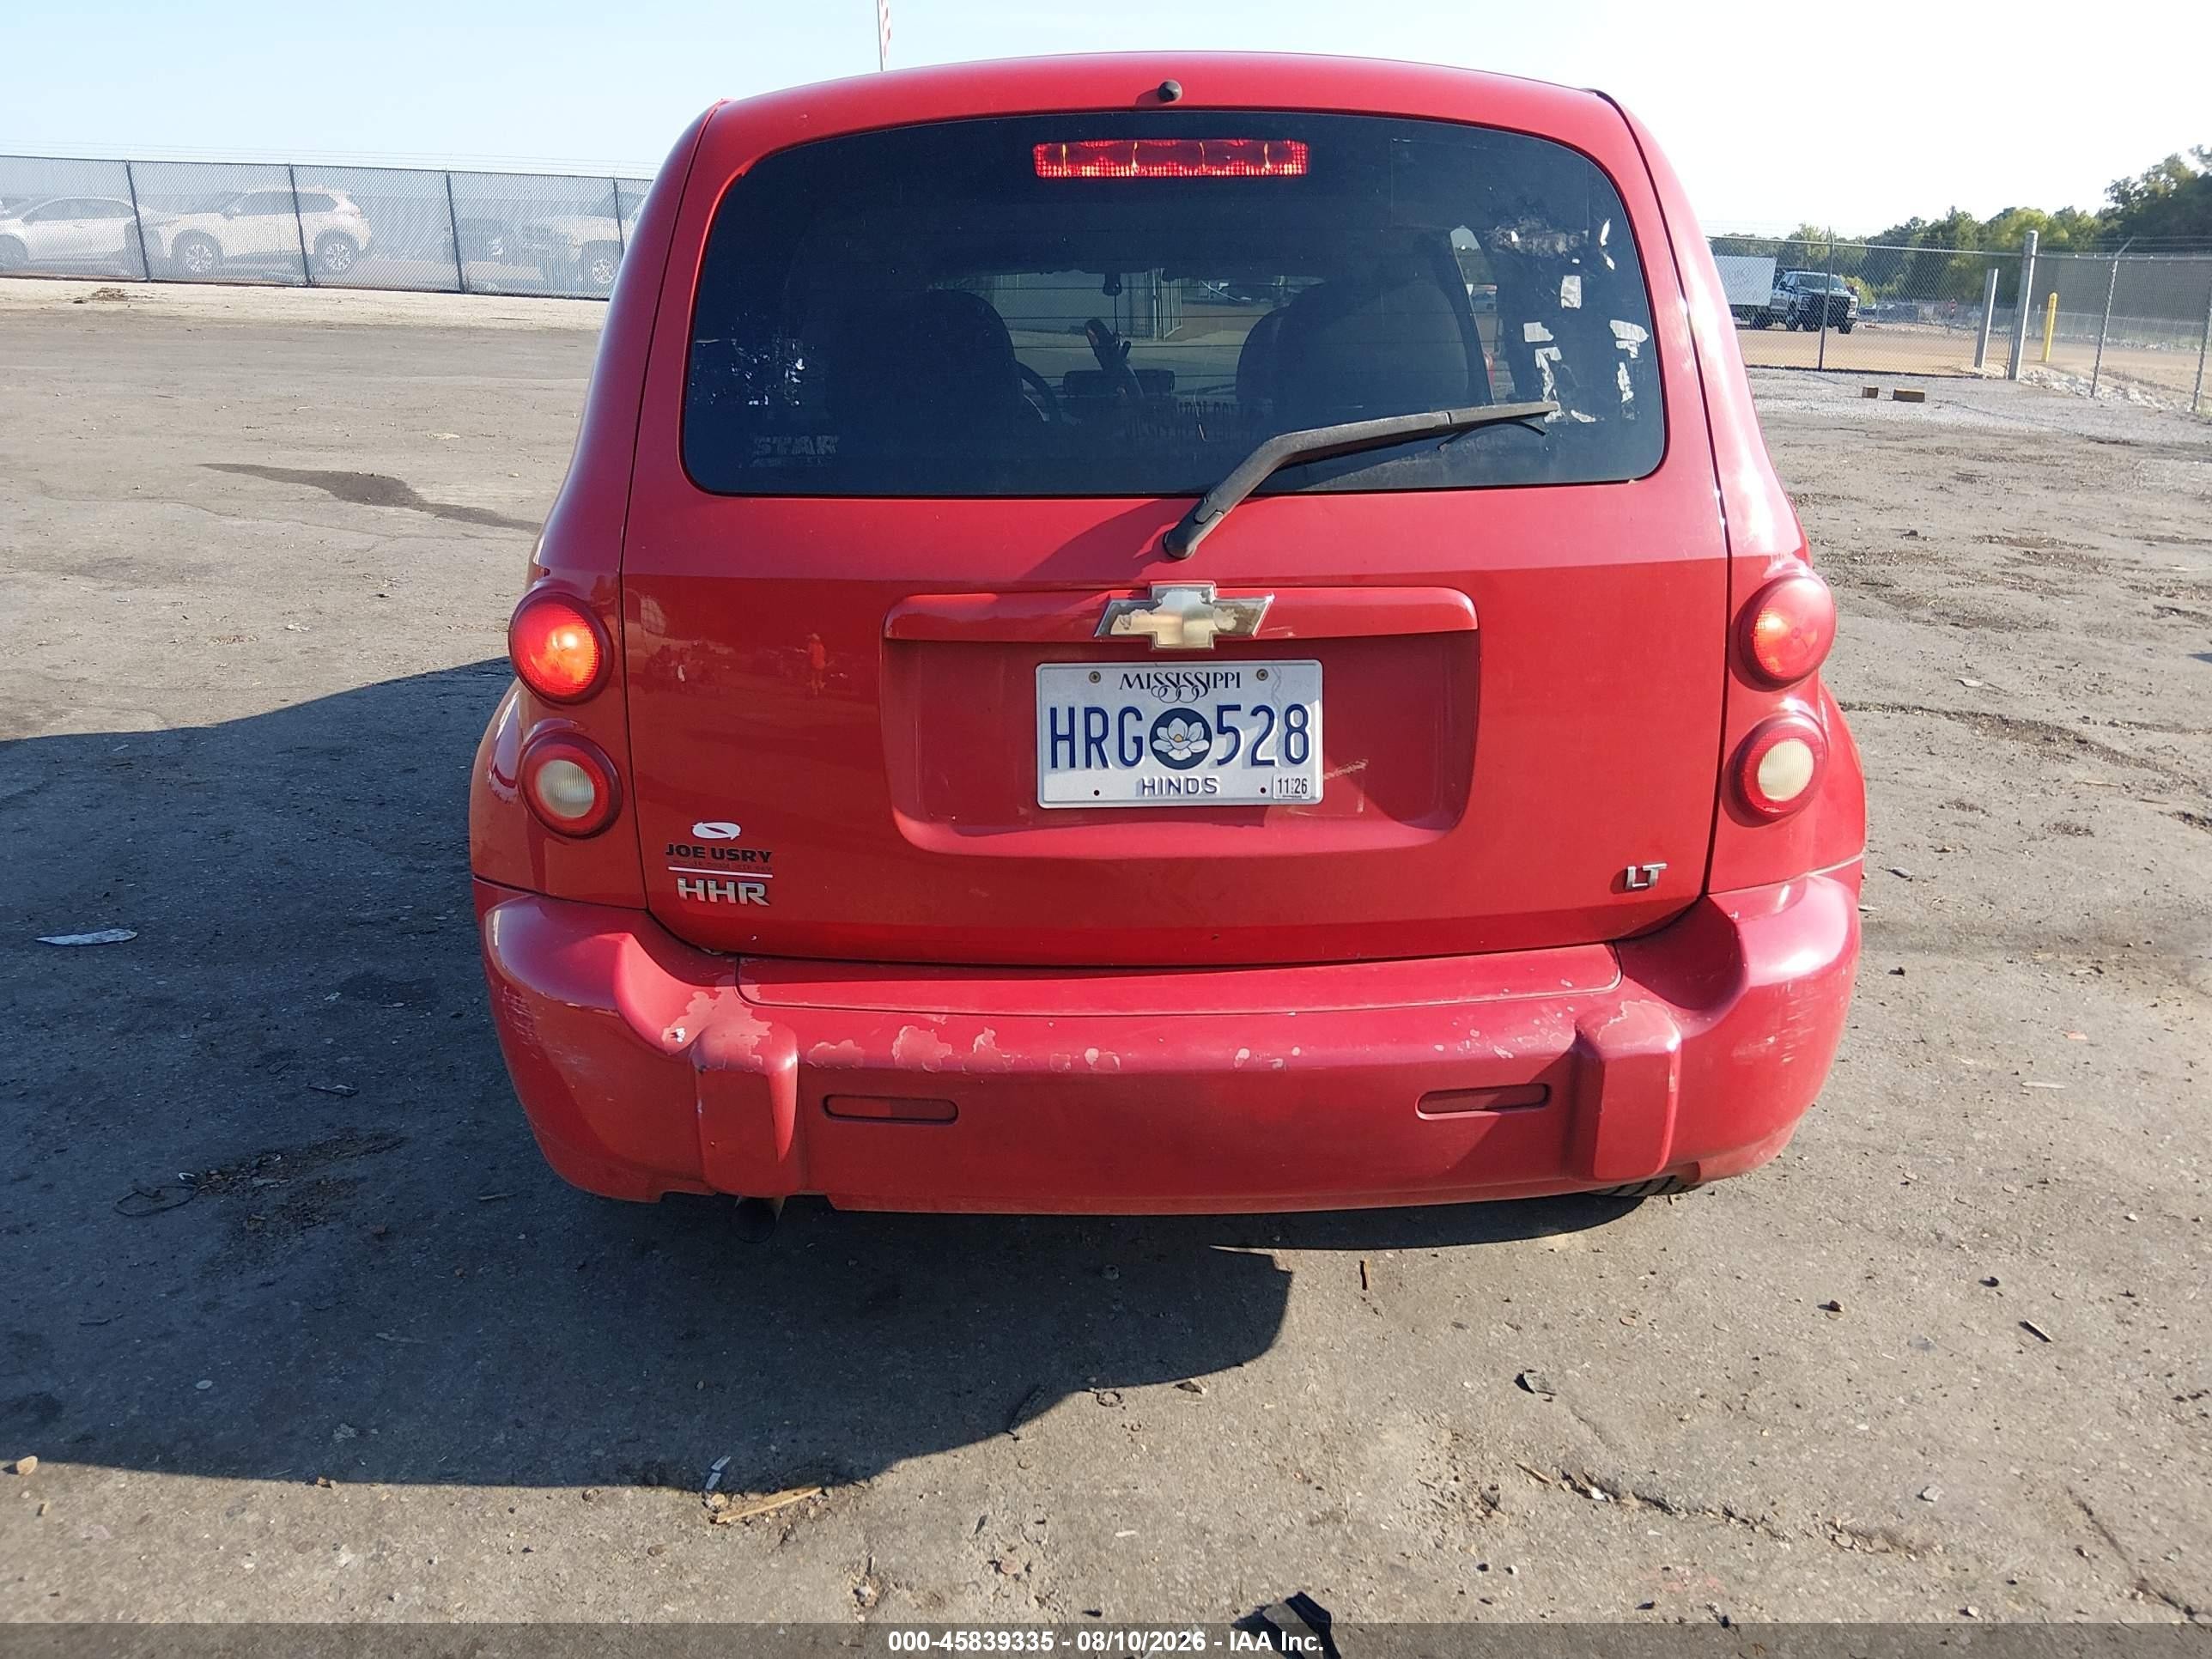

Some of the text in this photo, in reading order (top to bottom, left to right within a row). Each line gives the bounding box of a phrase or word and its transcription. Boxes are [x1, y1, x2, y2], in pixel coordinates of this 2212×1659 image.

[1119, 672, 1241, 703] MISSISSIPPI
[1049, 703, 1310, 769] HRG 528
[1141, 776, 1218, 796] HINDS
[665, 843, 773, 863] JOE USRY
[1625, 862, 1668, 890] LT
[677, 878, 770, 907] HHR
